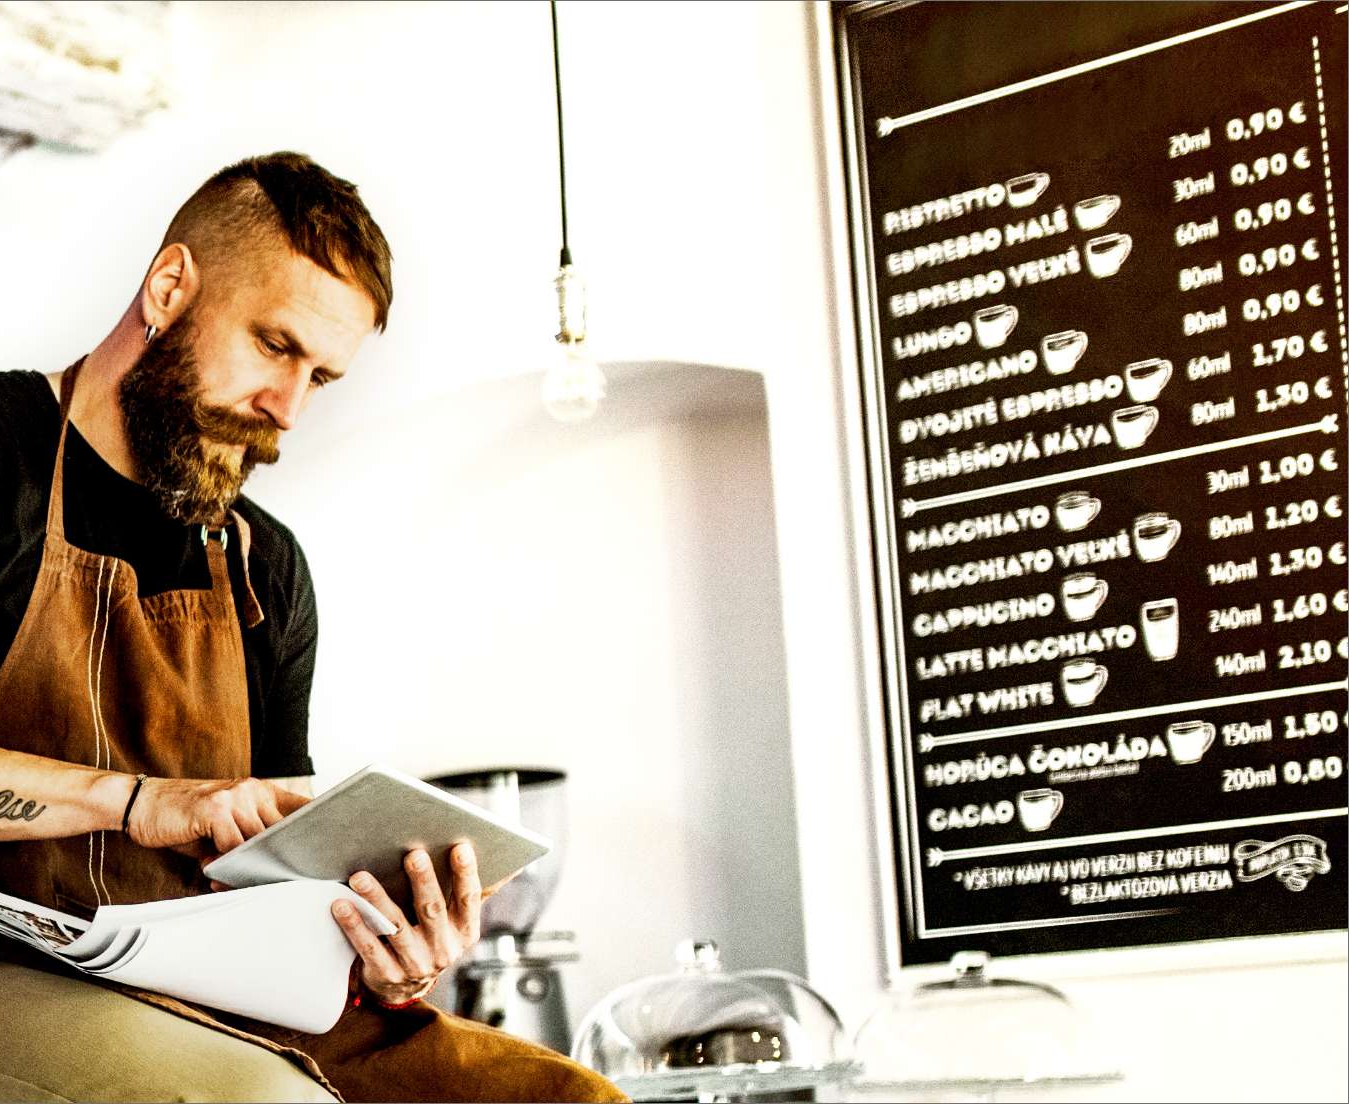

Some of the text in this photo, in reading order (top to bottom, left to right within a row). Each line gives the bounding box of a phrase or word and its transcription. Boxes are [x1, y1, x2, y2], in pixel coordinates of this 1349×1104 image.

[883, 184, 1005, 235] RISTRETTO
[1169, 127, 1211, 159] 20ml
[1288, 101, 1307, 124] €
[886, 227, 1002, 276] ESPRESSO
[1005, 204, 1068, 246] MALÉ
[1173, 171, 1215, 203] 30ml
[1293, 146, 1311, 170] €
[890, 270, 1005, 317] ESPRESSO
[1175, 216, 1219, 247] 60ml
[1297, 192, 1315, 215] €
[892, 322, 972, 359] LUNGO
[1179, 260, 1223, 291] 80ml
[1301, 237, 1320, 261] €
[898, 350, 1037, 401] AMERICANO
[1182, 305, 1227, 336] 80ml
[1305, 283, 1324, 307] €
[899, 397, 998, 443] DVOJITÉ
[1002, 375, 1124, 421] ESPRESSO
[1187, 350, 1232, 381] 60ml
[1309, 329, 1329, 353] €
[1043, 423, 1112, 456] KÁVA
[1190, 396, 1235, 426] 80ml
[1314, 376, 1333, 399] €
[907, 505, 1050, 553] MACCHIATO
[1206, 465, 1250, 495] 30ml
[1319, 447, 1338, 471] €
[909, 549, 1053, 595] MACCHIATO
[1208, 511, 1254, 540] 80ml
[1324, 494, 1343, 518] €
[913, 593, 1055, 637] CAPPUCINO
[1207, 557, 1258, 586] 140ml
[1328, 541, 1347, 565] €
[916, 648, 983, 680] LATTE
[987, 624, 1136, 669] MACCHIATO
[1208, 603, 1262, 633] 240ml
[920, 693, 973, 722] FLAT
[977, 682, 1054, 714] WHITE
[1215, 649, 1266, 677] 140ml
[924, 752, 1025, 787] HORÚCA
[1029, 733, 1167, 773] ČOKOLÁDA
[1221, 719, 1273, 746] 150ml
[927, 800, 1015, 832] CACAO
[1221, 764, 1277, 792] 200ml
[1137, 849, 1164, 872] BEZ
